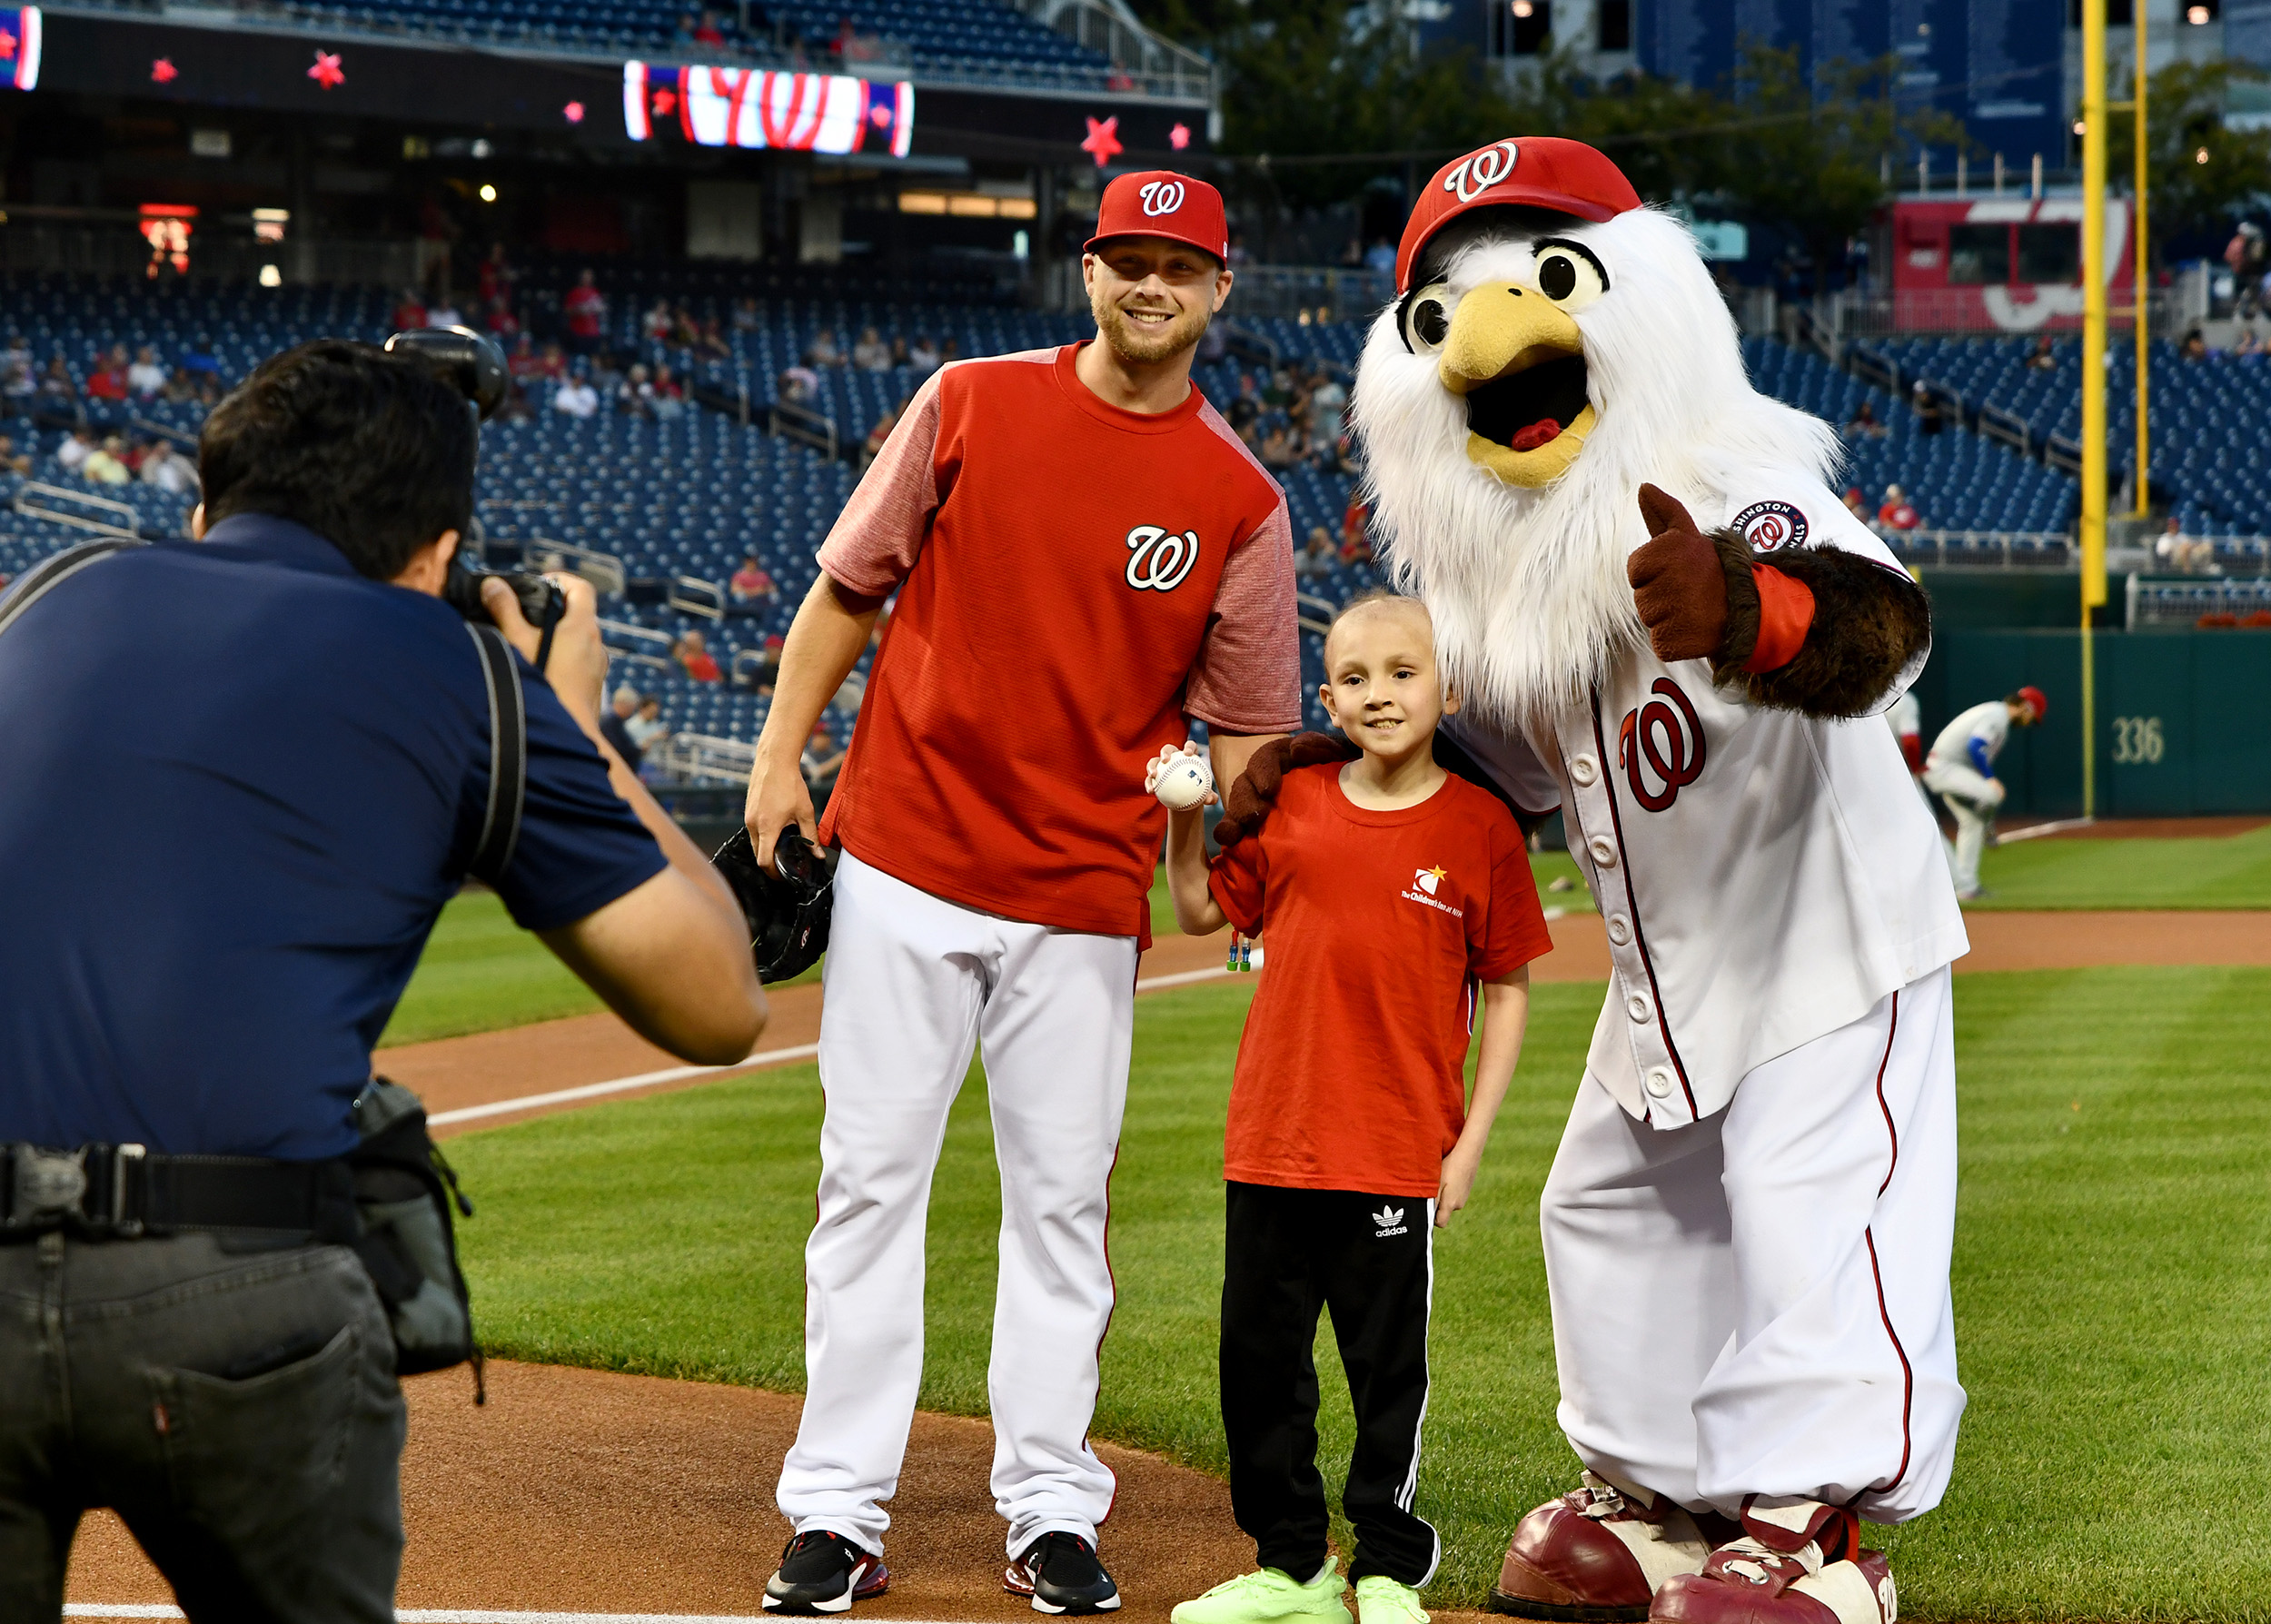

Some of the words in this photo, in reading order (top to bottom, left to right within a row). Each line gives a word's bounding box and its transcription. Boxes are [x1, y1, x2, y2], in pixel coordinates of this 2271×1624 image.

[1443, 142, 1518, 203] W
[1139, 181, 1185, 216] W
[1732, 502, 1790, 534] SHINGTON
[1750, 515, 1783, 550] W
[1125, 524, 1199, 592] W
[1619, 677, 1706, 812] W
[2111, 716, 2164, 764] 336
[1401, 890, 1410, 899] The
[1410, 892, 1438, 907] Children's
[1375, 1226, 1407, 1237] adidas
